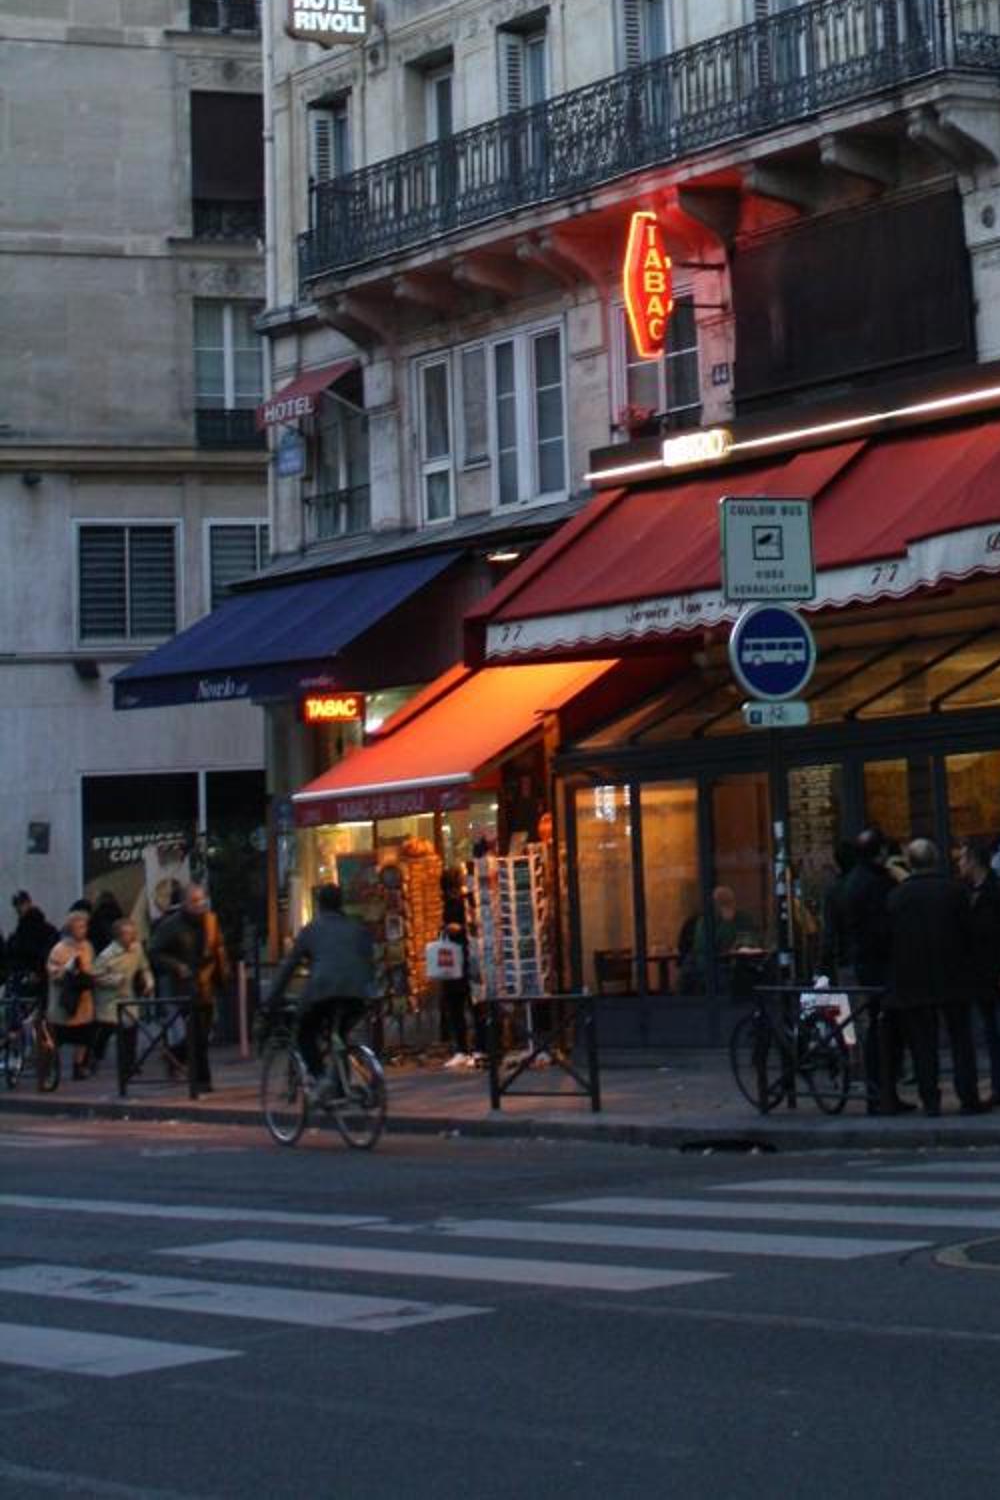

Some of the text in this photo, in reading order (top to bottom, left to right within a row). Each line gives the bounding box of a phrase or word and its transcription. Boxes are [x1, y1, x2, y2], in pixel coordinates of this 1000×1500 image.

[294, 11, 366, 33] RIVOLI
[643, 225, 666, 340] TABAC
[264, 396, 314, 421] HOTEL
[782, 505, 802, 516] BUS
[306, 700, 356, 718] TABAC
